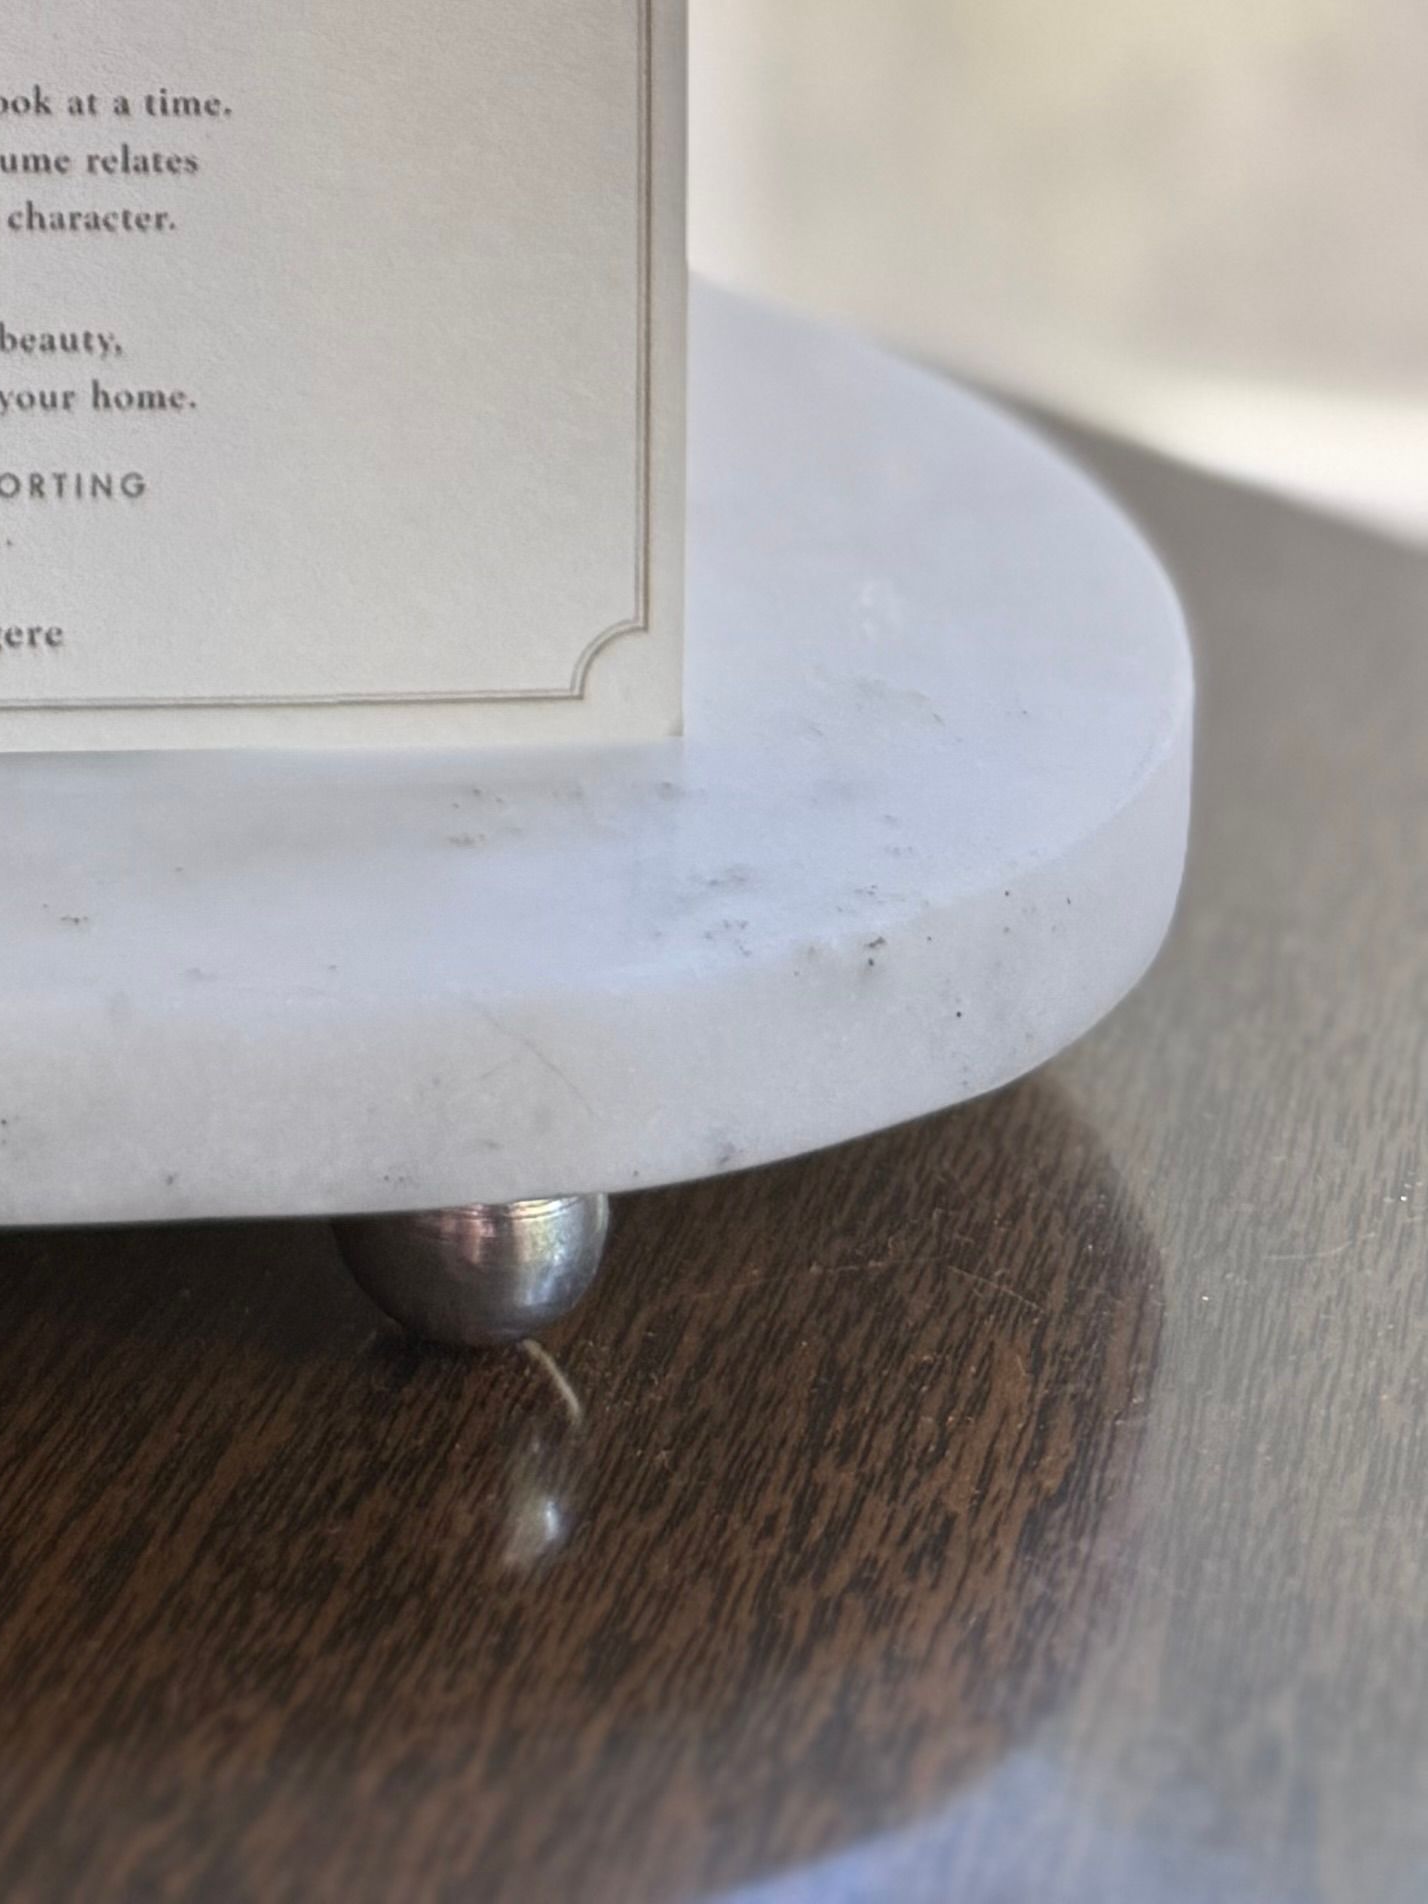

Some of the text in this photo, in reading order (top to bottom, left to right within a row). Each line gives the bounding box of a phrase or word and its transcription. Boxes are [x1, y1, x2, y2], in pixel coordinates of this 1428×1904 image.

[67, 89, 99, 118] at
[112, 95, 132, 118] a
[144, 85, 233, 118] time.
[86, 142, 201, 176] relates
[6, 199, 177, 234] character.
[91, 378, 198, 413] home.
